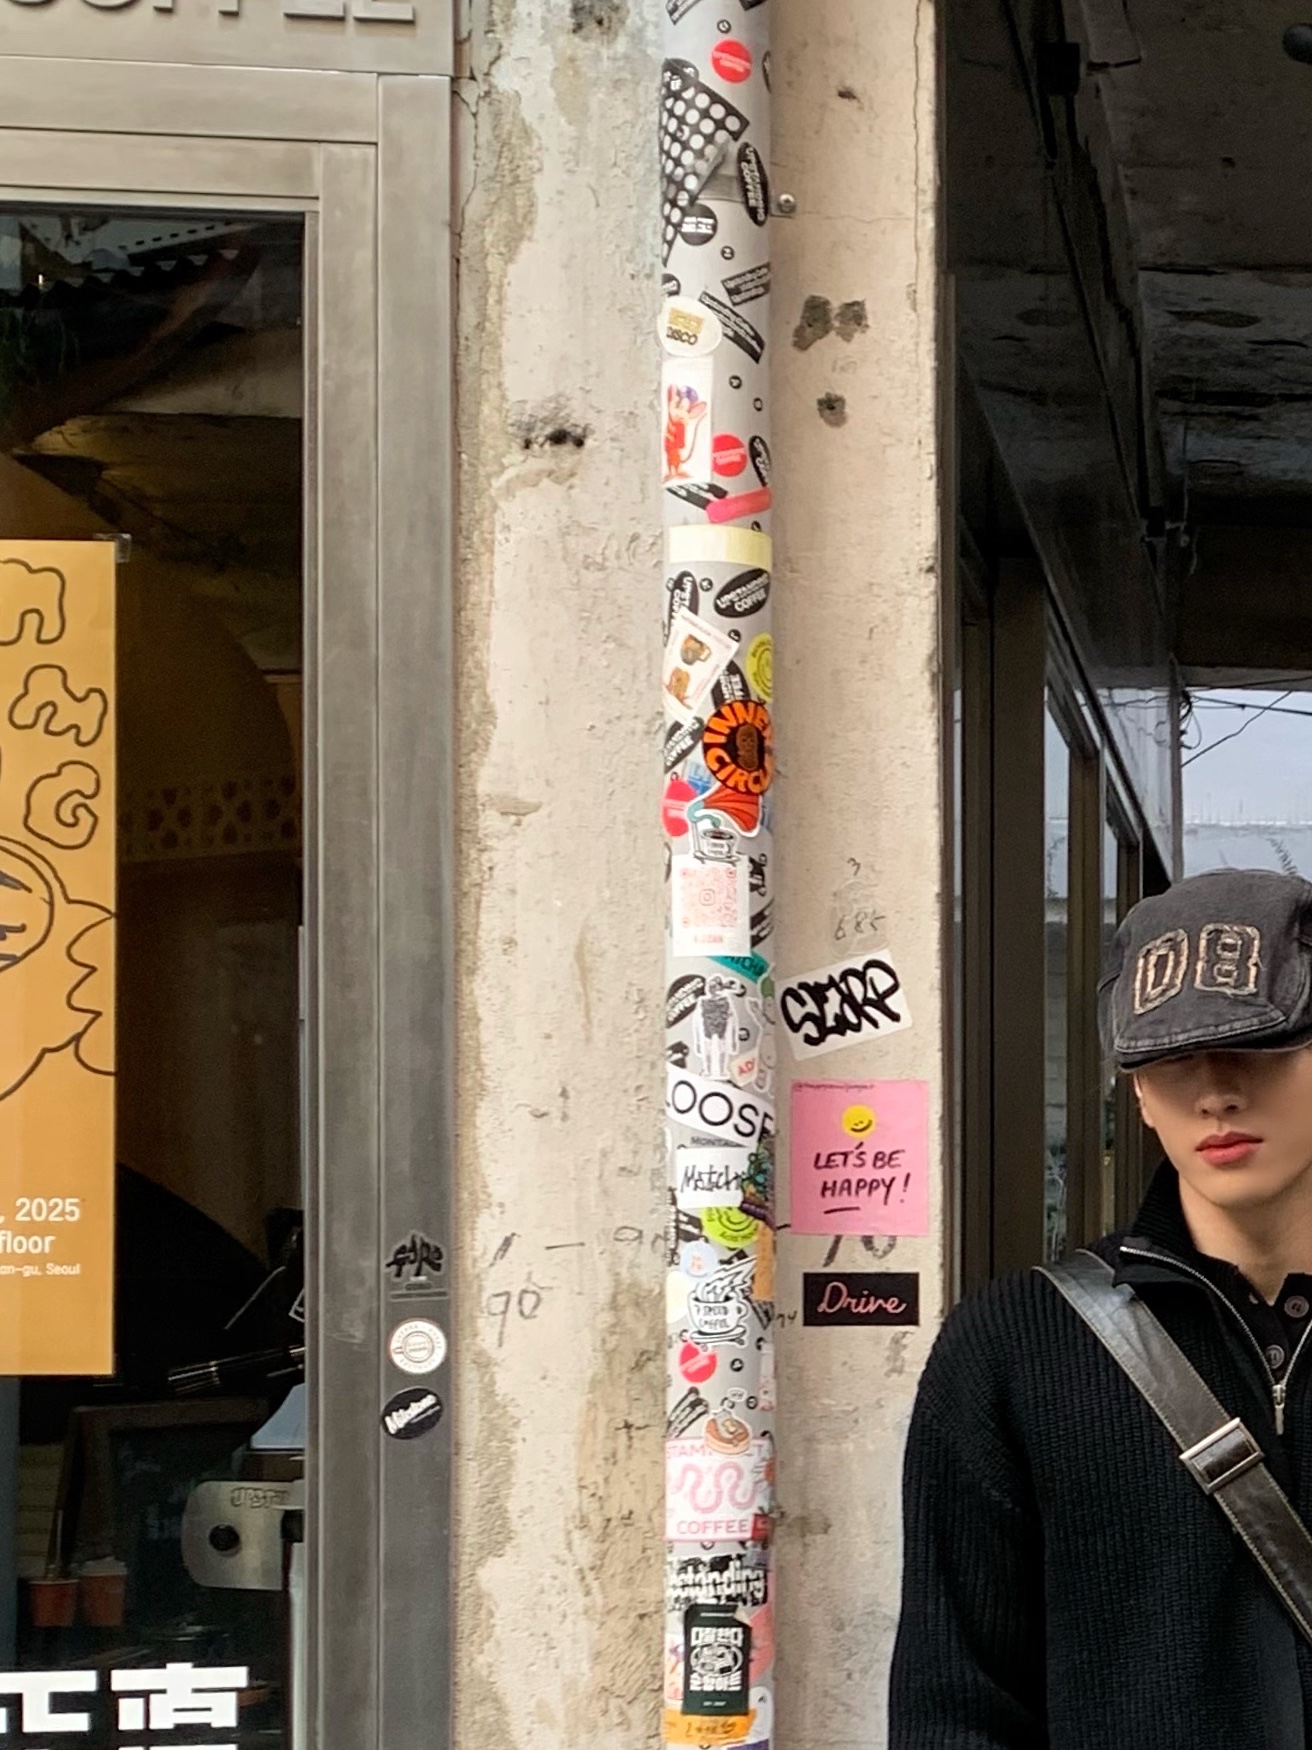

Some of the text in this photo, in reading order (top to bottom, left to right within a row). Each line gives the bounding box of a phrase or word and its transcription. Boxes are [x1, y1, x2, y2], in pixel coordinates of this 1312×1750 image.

[814, 1142, 905, 1169] LET'S BE
[15, 1197, 80, 1222] 2025
[0, 1230, 56, 1254] floor
[46, 1262, 81, 1276] Seoul
[817, 1281, 907, 1313] Drive
[677, 1520, 749, 1535] COFFEE
